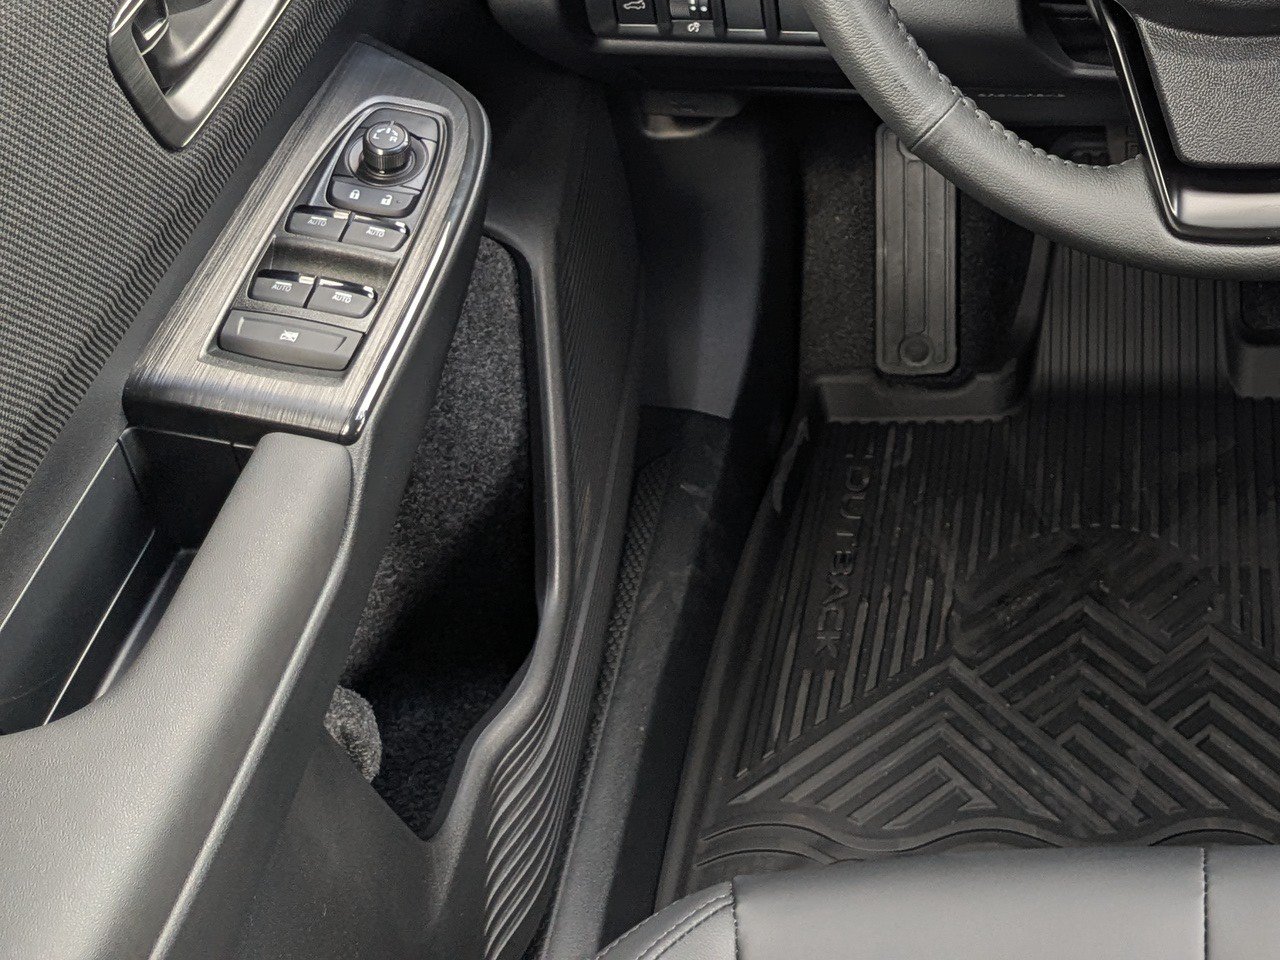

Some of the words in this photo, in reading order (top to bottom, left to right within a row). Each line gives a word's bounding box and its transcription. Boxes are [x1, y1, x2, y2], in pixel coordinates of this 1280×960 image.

[307, 218, 327, 227] AUTO
[366, 227, 385, 237] AUTO
[271, 283, 292, 292] AUTO
[332, 294, 352, 304] AUTO
[817, 465, 870, 660] OUTBACK
